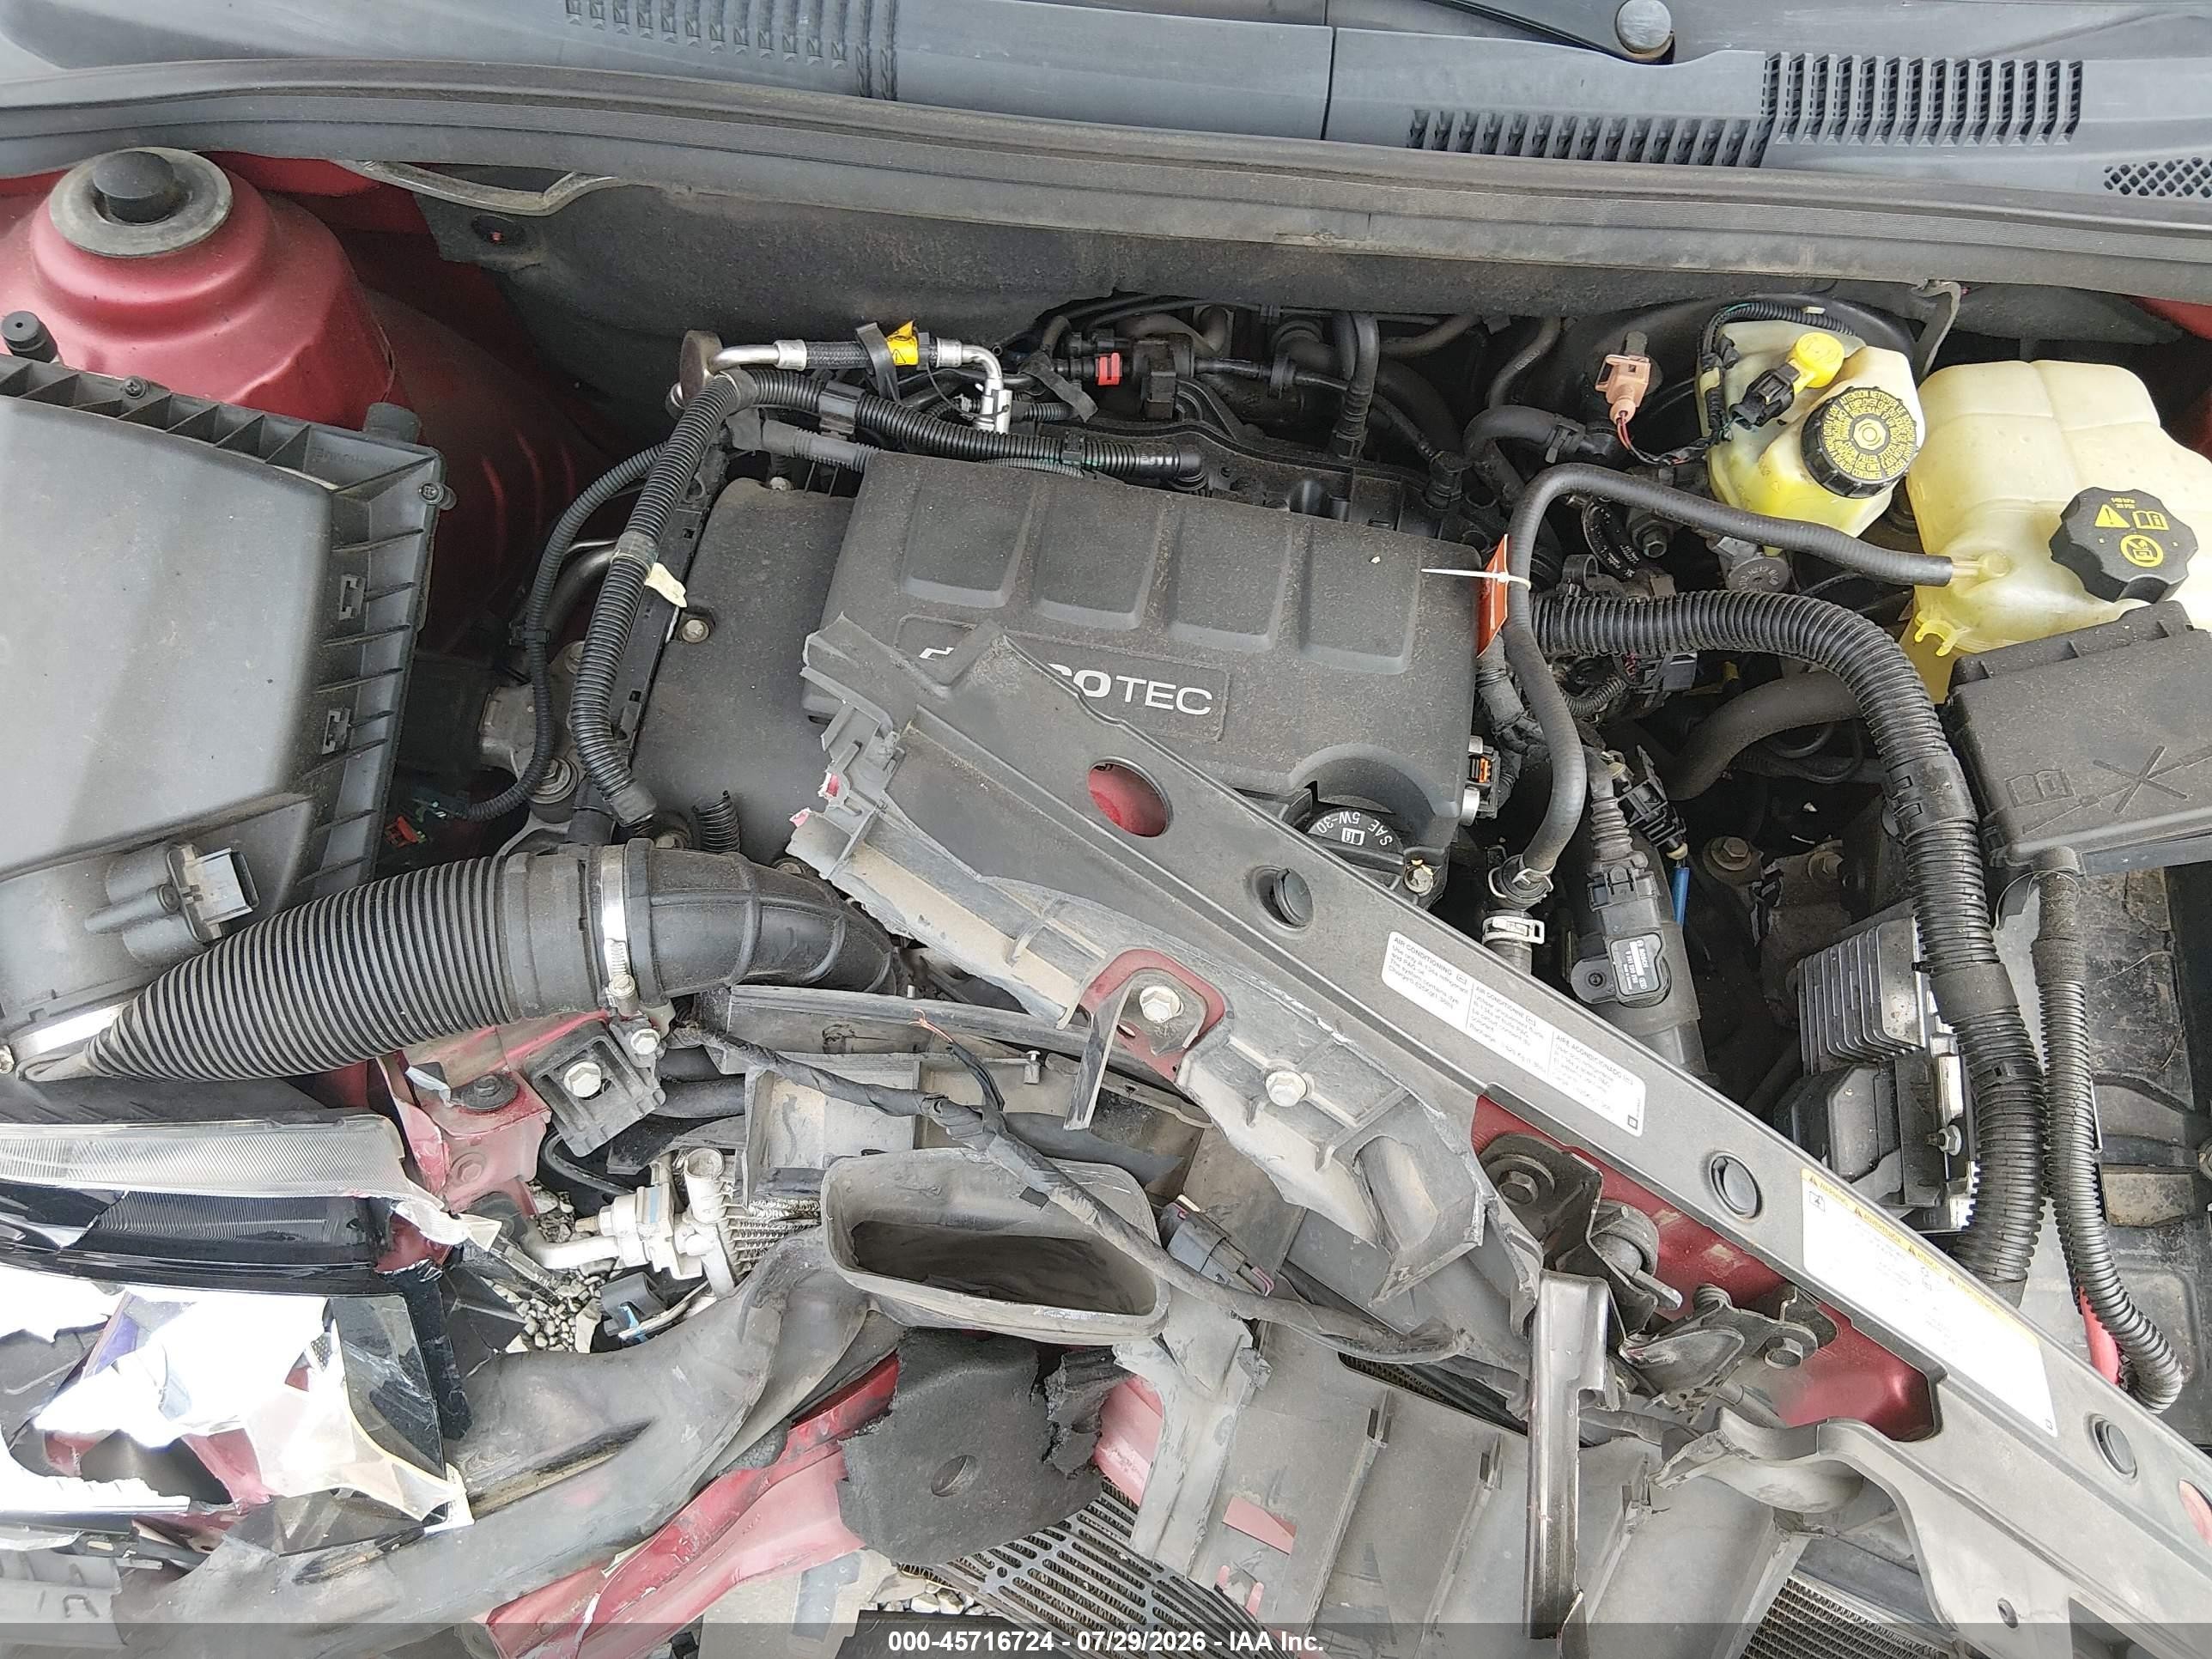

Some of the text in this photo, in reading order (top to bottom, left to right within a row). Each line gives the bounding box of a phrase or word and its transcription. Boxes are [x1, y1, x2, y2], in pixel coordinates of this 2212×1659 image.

[1317, 811, 1393, 846] SAE 5W-30
[1394, 937, 1453, 977] AIR CONDITIONING
[1639, 949, 1649, 969] BOSCH
[1476, 985, 1486, 996] AIR
[1820, 1182, 1848, 1206] WARNING
[1864, 1214, 1901, 1243] ADVERTENCIA
